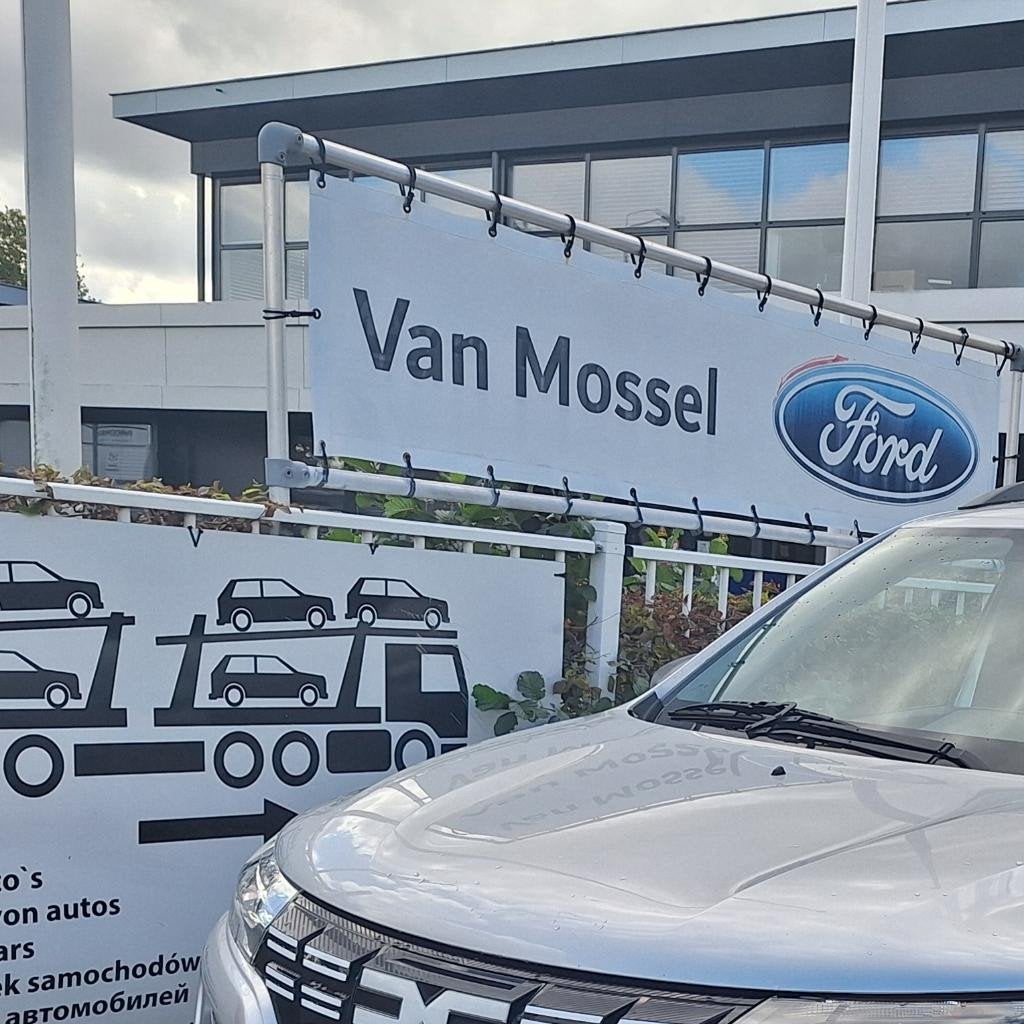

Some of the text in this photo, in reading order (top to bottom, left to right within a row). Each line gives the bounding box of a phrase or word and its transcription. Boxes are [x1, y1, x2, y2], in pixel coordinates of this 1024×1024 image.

[352, 287, 718, 436] Van Mossel
[818, 384, 944, 484] Ford
[0, 866, 43, 891] o`s
[46, 898, 121, 922] autos
[27, 952, 201, 993] samochodów
